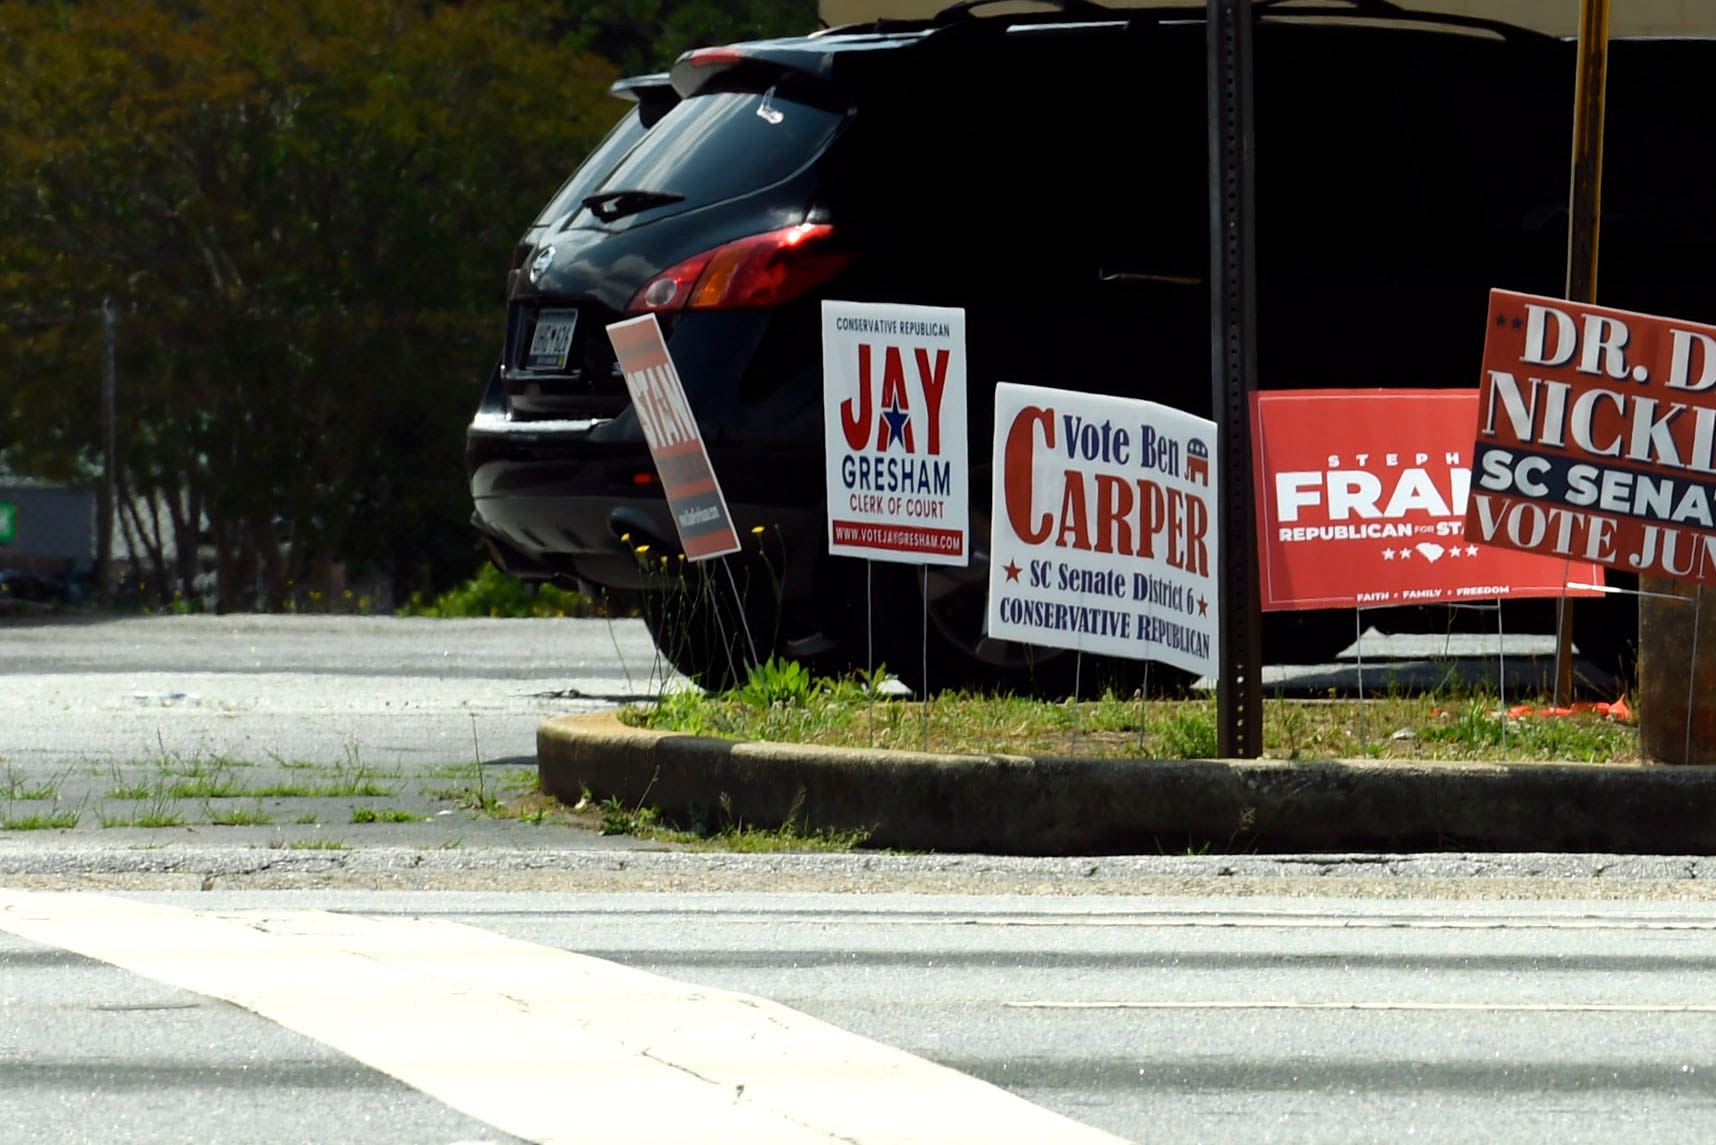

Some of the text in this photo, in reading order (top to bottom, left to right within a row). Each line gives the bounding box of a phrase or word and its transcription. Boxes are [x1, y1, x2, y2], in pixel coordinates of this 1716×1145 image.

[836, 317, 950, 337] CONSERVATIVE REPUBLICAN
[1519, 303, 1650, 384] DR.
[840, 343, 950, 456] JAY
[1063, 414, 1180, 478] Vote Ben
[842, 454, 950, 497] GRESHAM
[1004, 405, 1209, 578] CARPER
[1479, 449, 1552, 498] SC
[849, 493, 944, 519] CLERK OF COURT
[1279, 521, 1467, 543] REPUBLICAN FOR ST
[1474, 494, 1618, 564] VOTE
[835, 526, 961, 550] WWW.VOTEJAYGRESHAM.COM
[1030, 559, 1194, 615] SC Senate District 6
[1357, 585, 1510, 603] FAITH FAMILY FREEDOM
[1000, 597, 1210, 660] CONSERVATIVE REPUBLICAN
